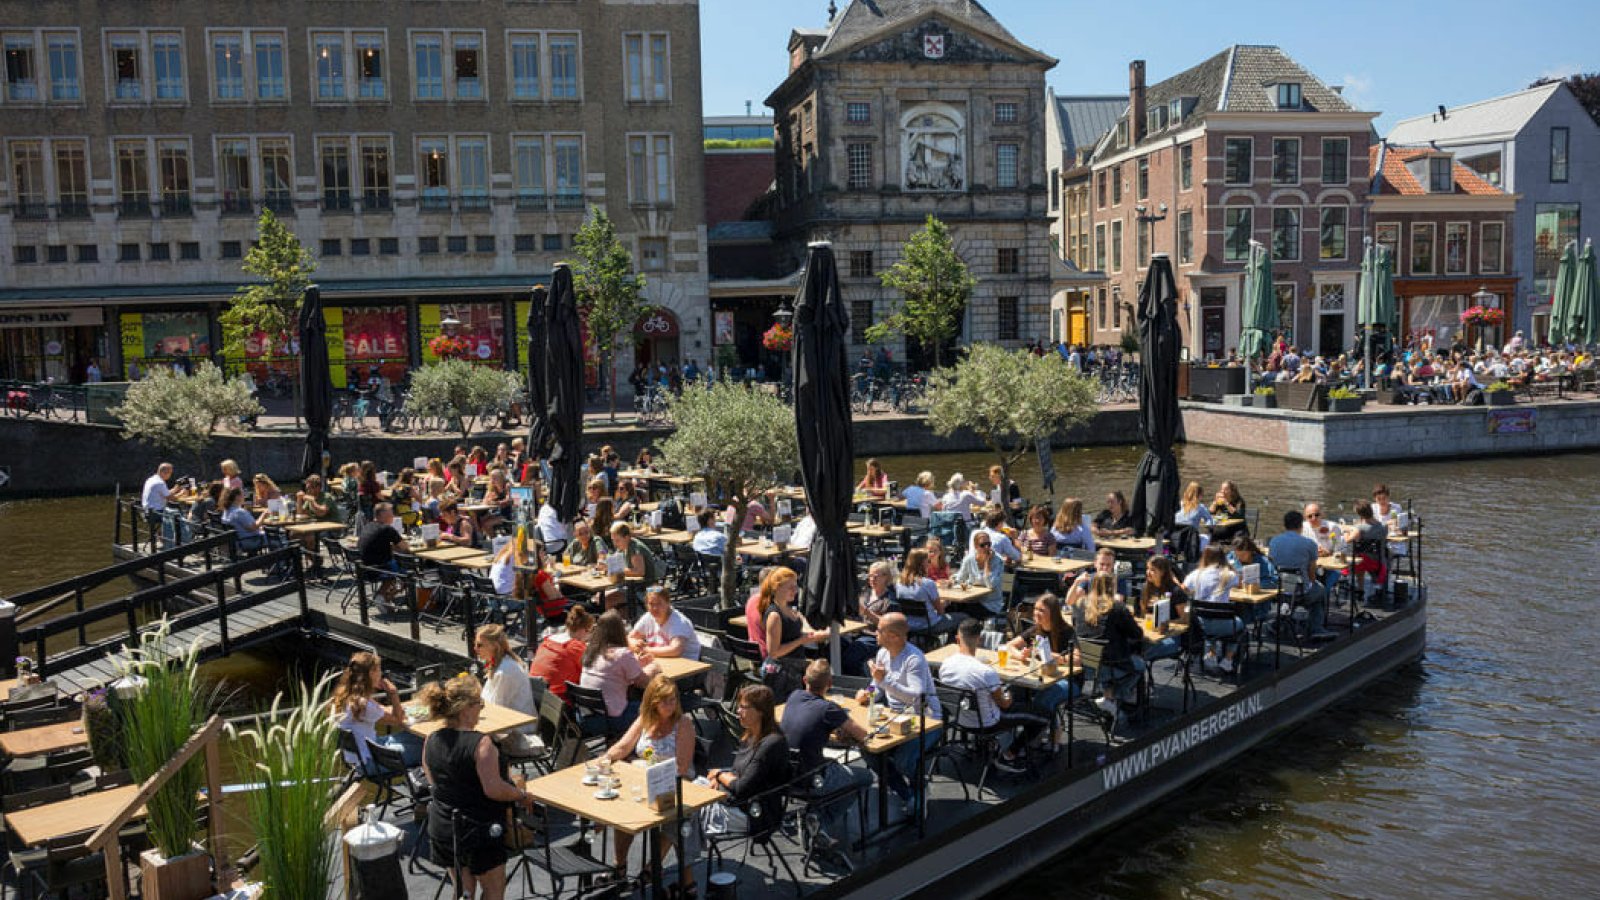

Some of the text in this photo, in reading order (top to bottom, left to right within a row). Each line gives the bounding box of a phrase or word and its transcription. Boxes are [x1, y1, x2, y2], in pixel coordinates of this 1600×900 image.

[39, 312, 71, 321] BAY
[344, 338, 397, 354] SALE
[1102, 692, 1263, 790] WWW.PVANBERGEN.NL
